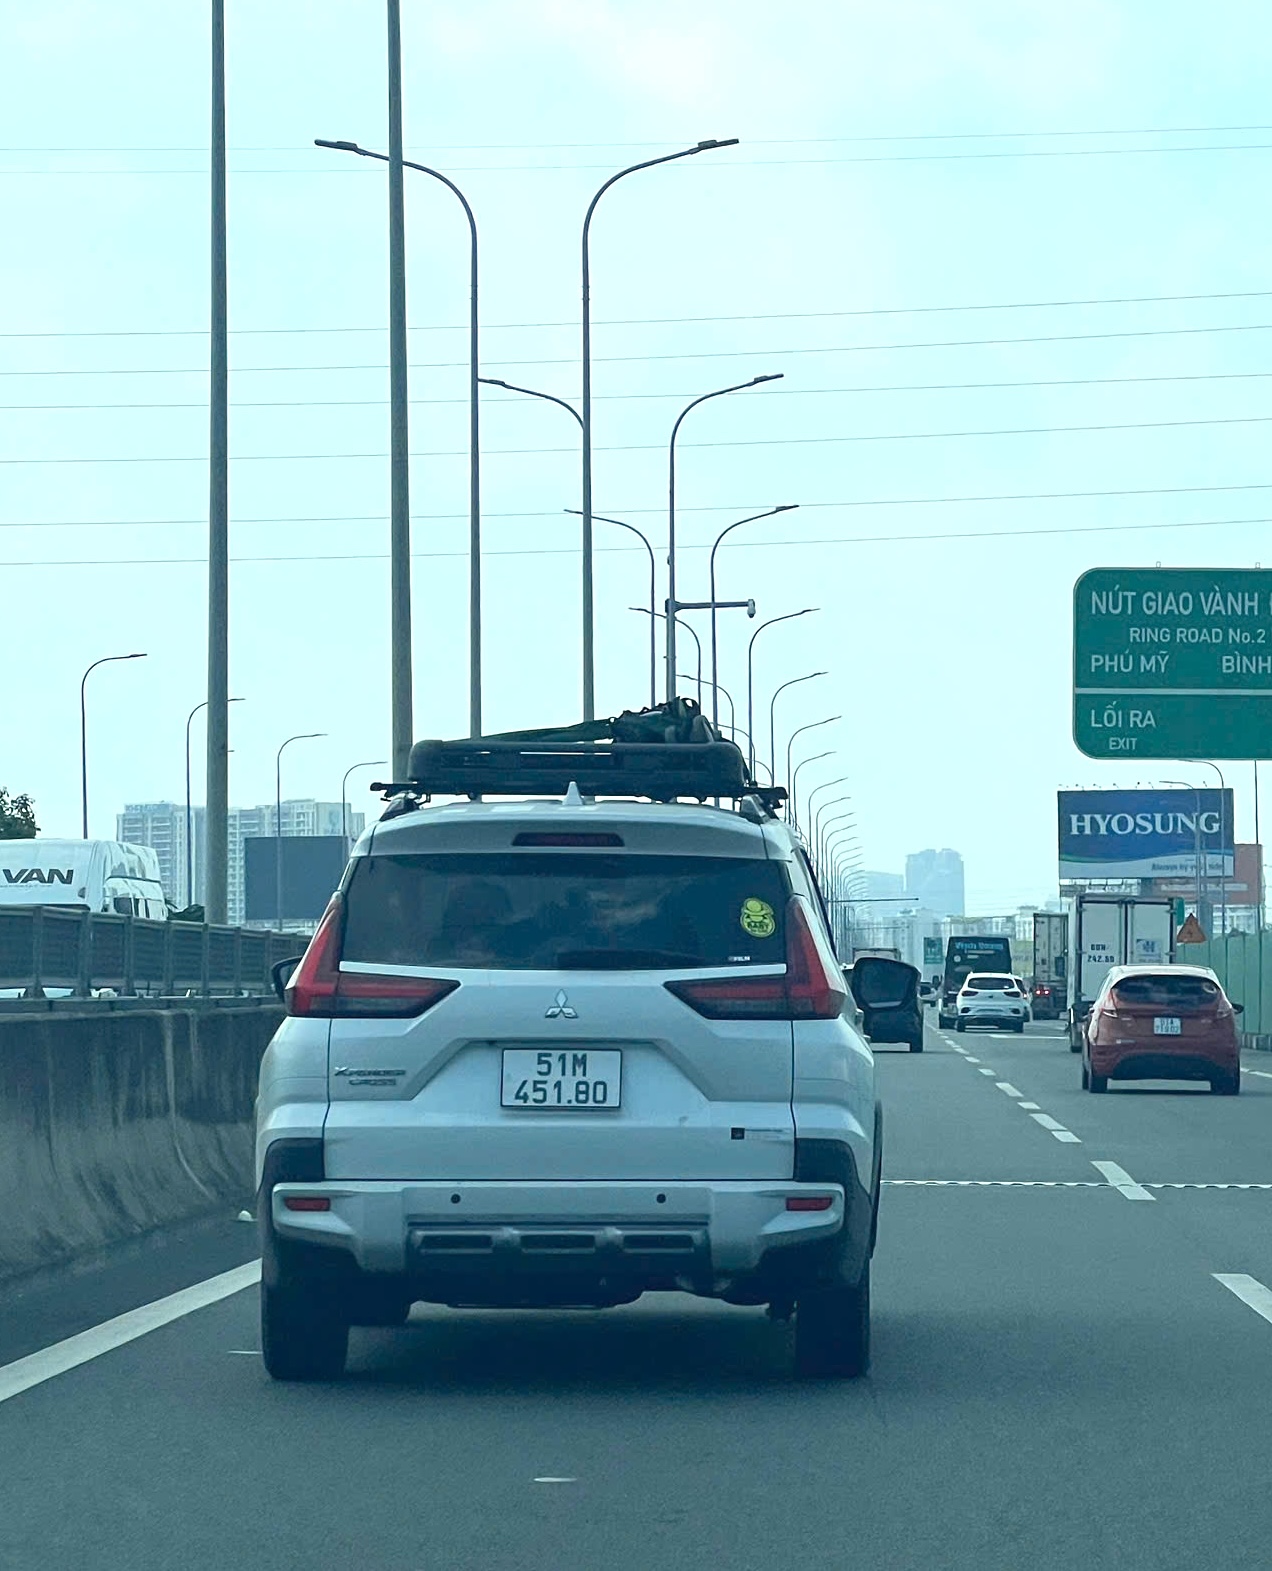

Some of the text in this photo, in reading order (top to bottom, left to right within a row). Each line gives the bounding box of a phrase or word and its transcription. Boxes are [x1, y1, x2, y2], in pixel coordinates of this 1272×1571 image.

[1090, 584, 1136, 616] NÚT
[1142, 591, 1193, 616] GIAO
[1200, 585, 1259, 617] VÀNH
[1129, 627, 1171, 643] RING
[1176, 628, 1223, 644] ROAD
[1228, 628, 1266, 644] No.2
[1090, 649, 1170, 674] PHÚ MỸ
[1221, 651, 1272, 675] BÌNH
[1090, 701, 1157, 729] LỐI RA
[1108, 737, 1138, 751] EXIT
[1069, 811, 1221, 836] HYOSUNG
[2, 868, 74, 885] VAN
[536, 1052, 587, 1077] 51M
[514, 1079, 608, 1105] 451.80
